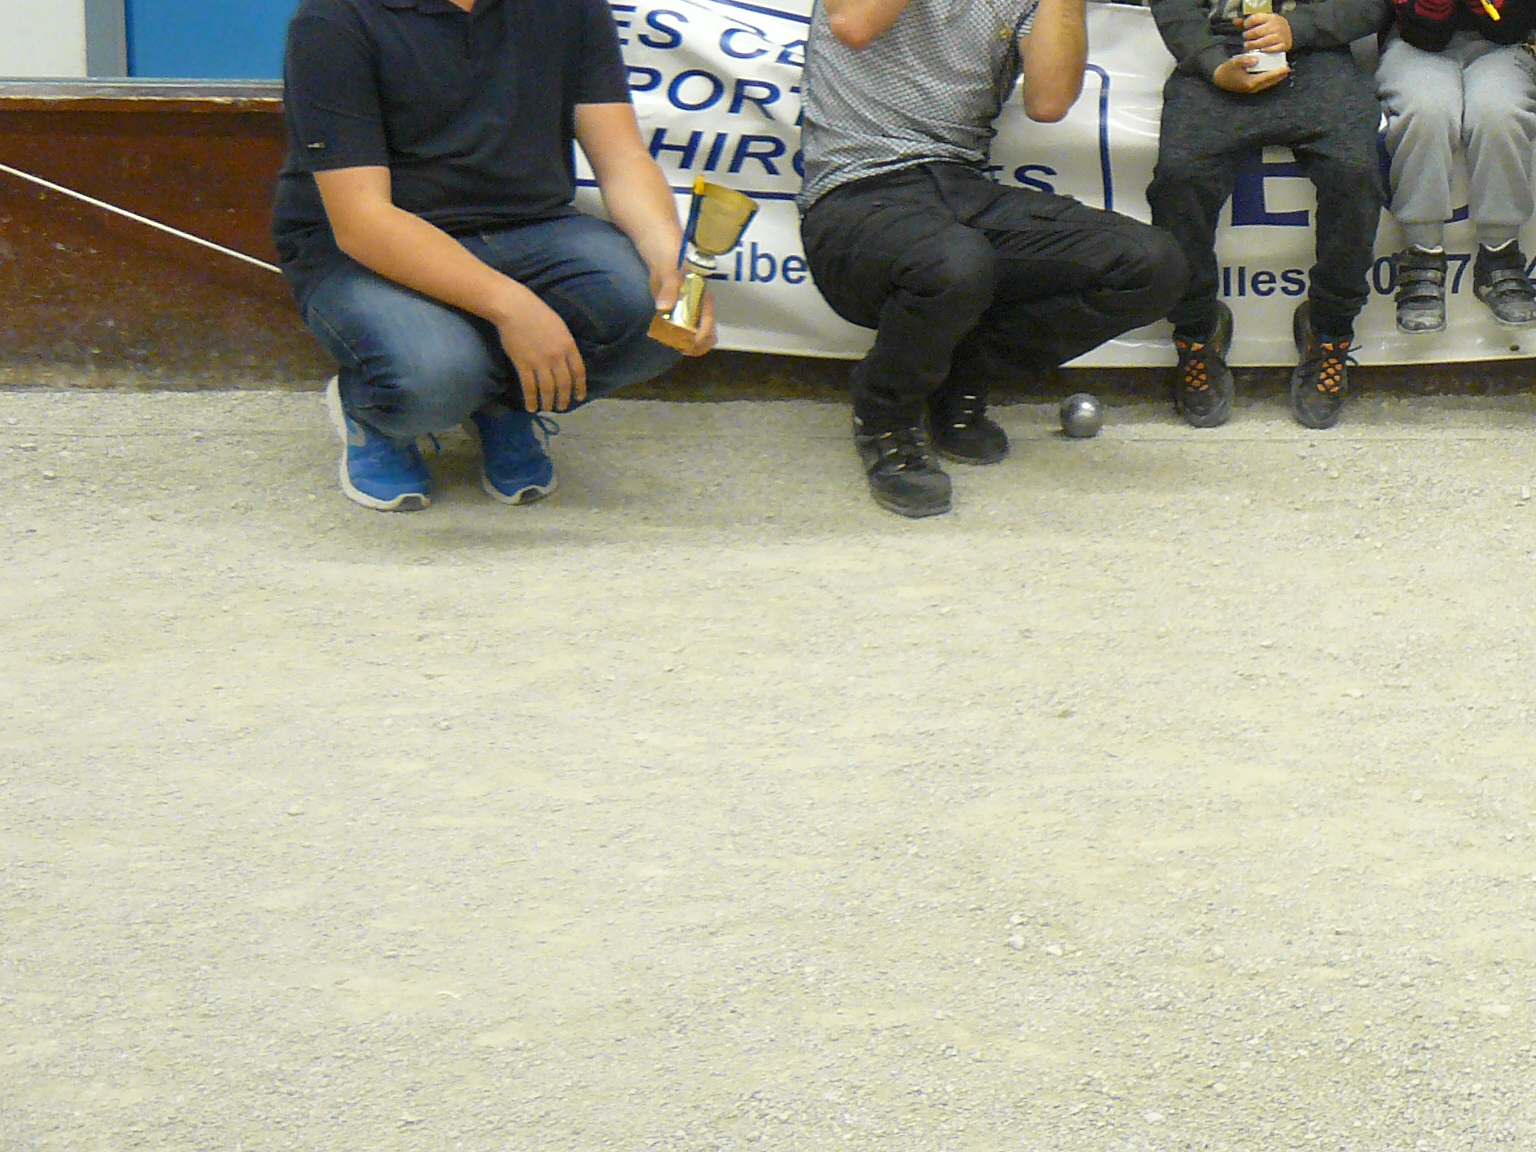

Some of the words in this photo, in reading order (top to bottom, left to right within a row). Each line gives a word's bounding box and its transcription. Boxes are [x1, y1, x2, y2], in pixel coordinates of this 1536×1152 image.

[626, 64, 802, 127] POR
[648, 128, 805, 177] HIR
[704, 241, 808, 285] ibe
